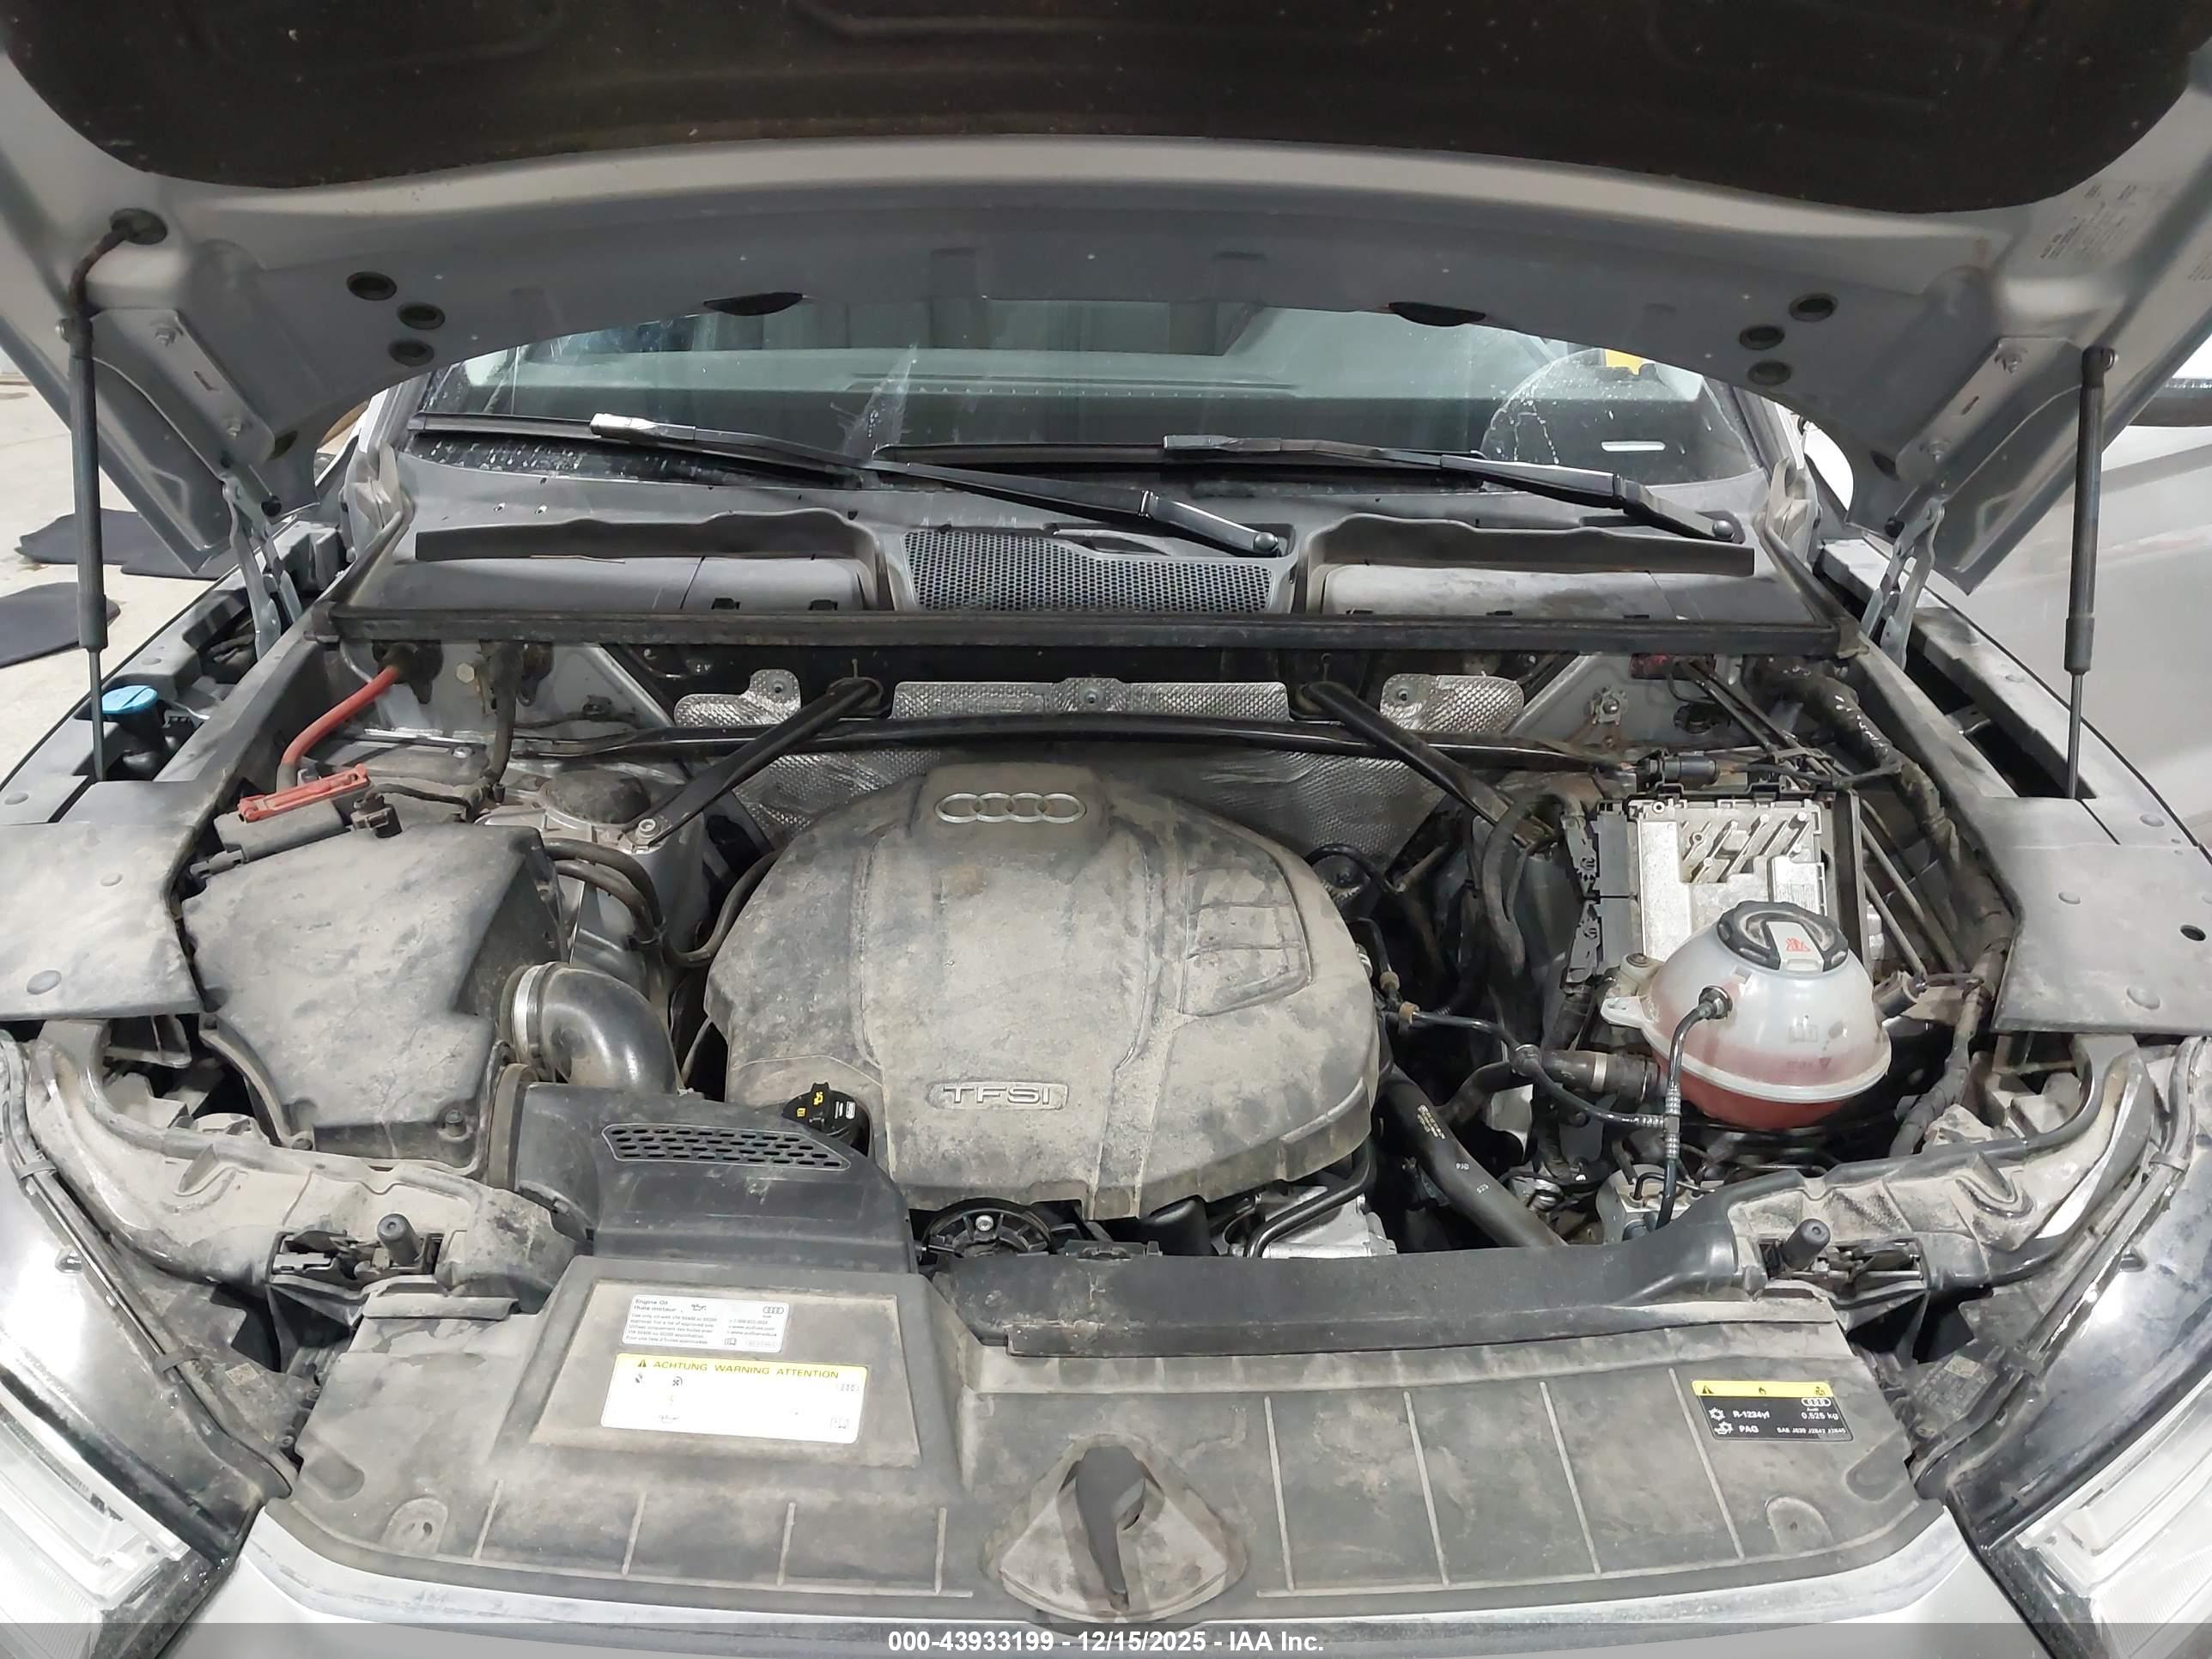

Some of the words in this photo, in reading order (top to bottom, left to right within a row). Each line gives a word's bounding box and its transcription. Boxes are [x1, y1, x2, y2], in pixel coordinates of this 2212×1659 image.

[943, 1086, 1050, 1105] TFSI
[653, 1361, 708, 1372] ACHTUNG
[714, 1364, 769, 1375] WARNING
[776, 1367, 839, 1379] ATTENTION
